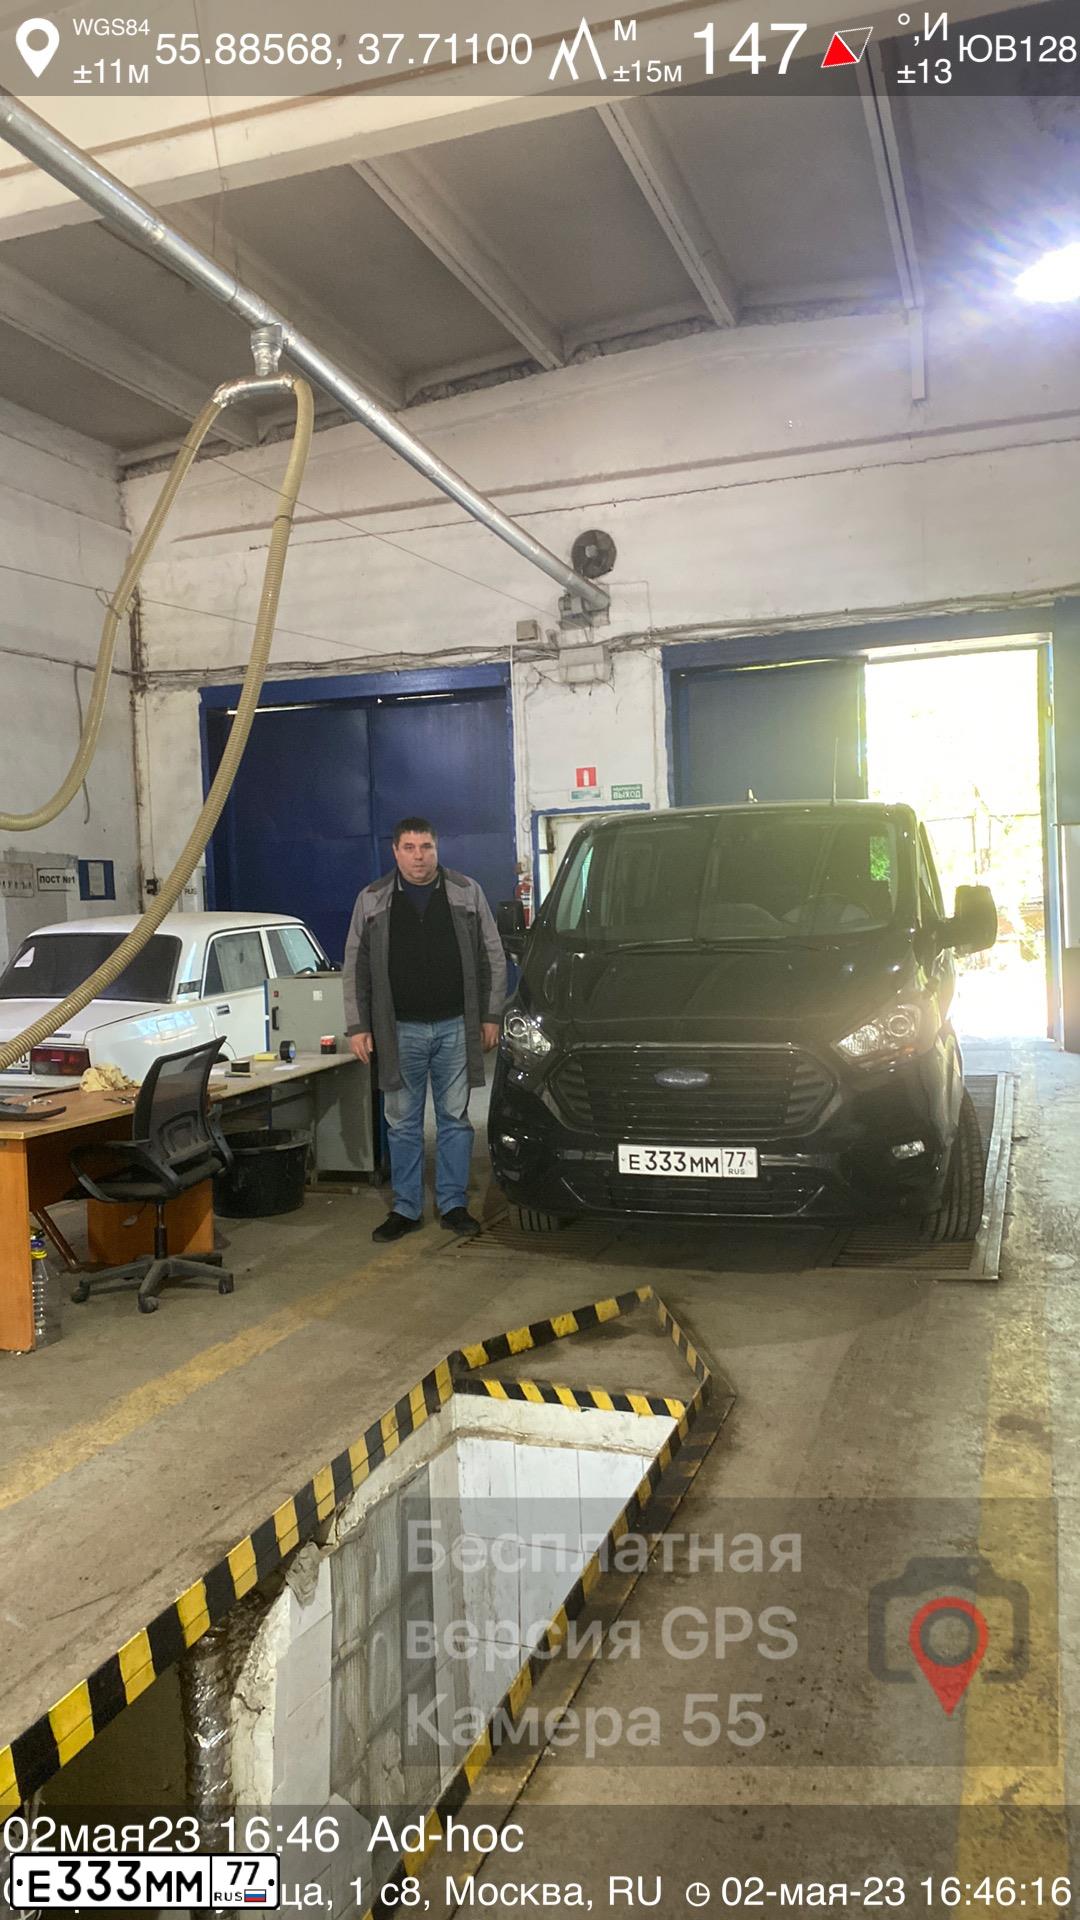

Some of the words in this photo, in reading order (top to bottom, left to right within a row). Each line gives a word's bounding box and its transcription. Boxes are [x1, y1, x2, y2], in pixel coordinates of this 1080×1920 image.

[613, 790, 641, 799] ВЫХОД
[39, 875, 61, 884] ПОСТ
[62, 876, 76, 884] №1
[724, 1151, 747, 1168] 77
[728, 1168, 746, 1176] RUS
